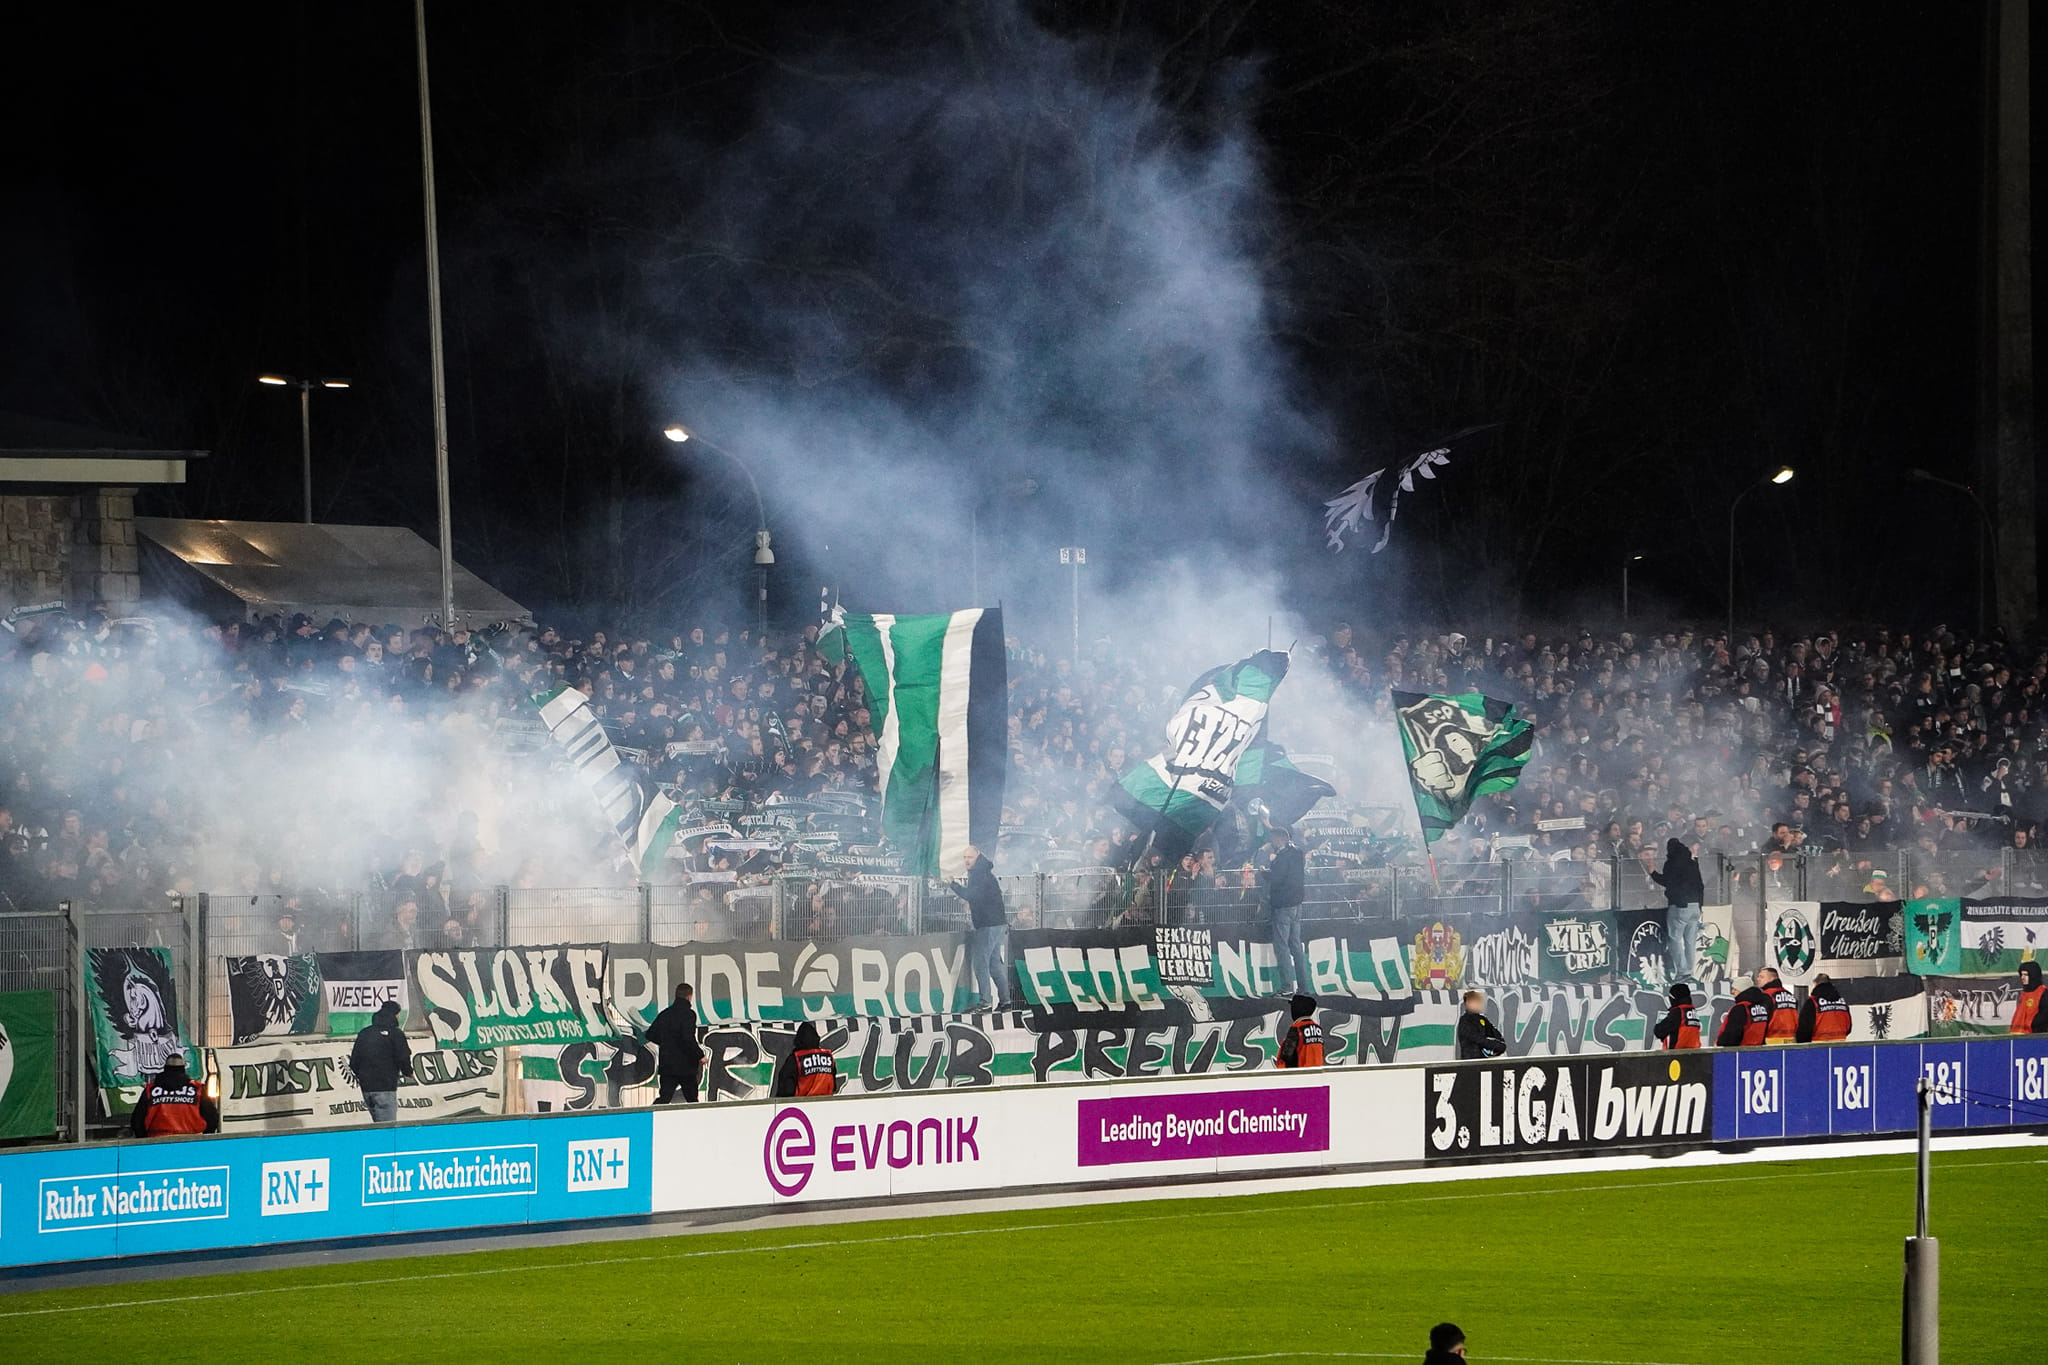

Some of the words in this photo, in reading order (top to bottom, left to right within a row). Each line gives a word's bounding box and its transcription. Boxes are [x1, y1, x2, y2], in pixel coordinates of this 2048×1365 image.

[1424, 705, 1454, 725] SCP
[1156, 927, 1211, 944] SEKTION
[1822, 908, 1880, 936] Preußen
[1156, 943, 1212, 961] STADION
[1158, 959, 1213, 978] VERBOT
[275, 980, 284, 995] P
[477, 1021, 555, 1044] SPORTCLUB
[557, 1019, 583, 1039] 1906
[229, 1057, 336, 1100] WEST
[398, 1049, 498, 1087] GLES
[803, 1054, 832, 1068] atlas
[2015, 1057, 2048, 1101] 1&1
[174, 1096, 194, 1104] SHOES
[1593, 1059, 1708, 1141] bwin
[1741, 1069, 1779, 1114] 1&1
[1834, 1065, 1870, 1110] 1&1
[1925, 1061, 1962, 1106] 1&1
[1431, 1072, 1471, 1150] 3.
[1479, 1066, 1581, 1147] LIGA
[831, 1116, 979, 1172] EVONIK
[1101, 1115, 1162, 1146] Leading
[1166, 1110, 1224, 1145] Beyond
[1227, 1108, 1308, 1138] Chemistry
[368, 1162, 414, 1195] Ruhr
[418, 1155, 532, 1190] Nachrichten
[572, 1148, 624, 1183] RN+
[45, 1186, 96, 1221] Ruhr
[101, 1178, 222, 1217] Nachrichten
[268, 1169, 324, 1206] RN+
